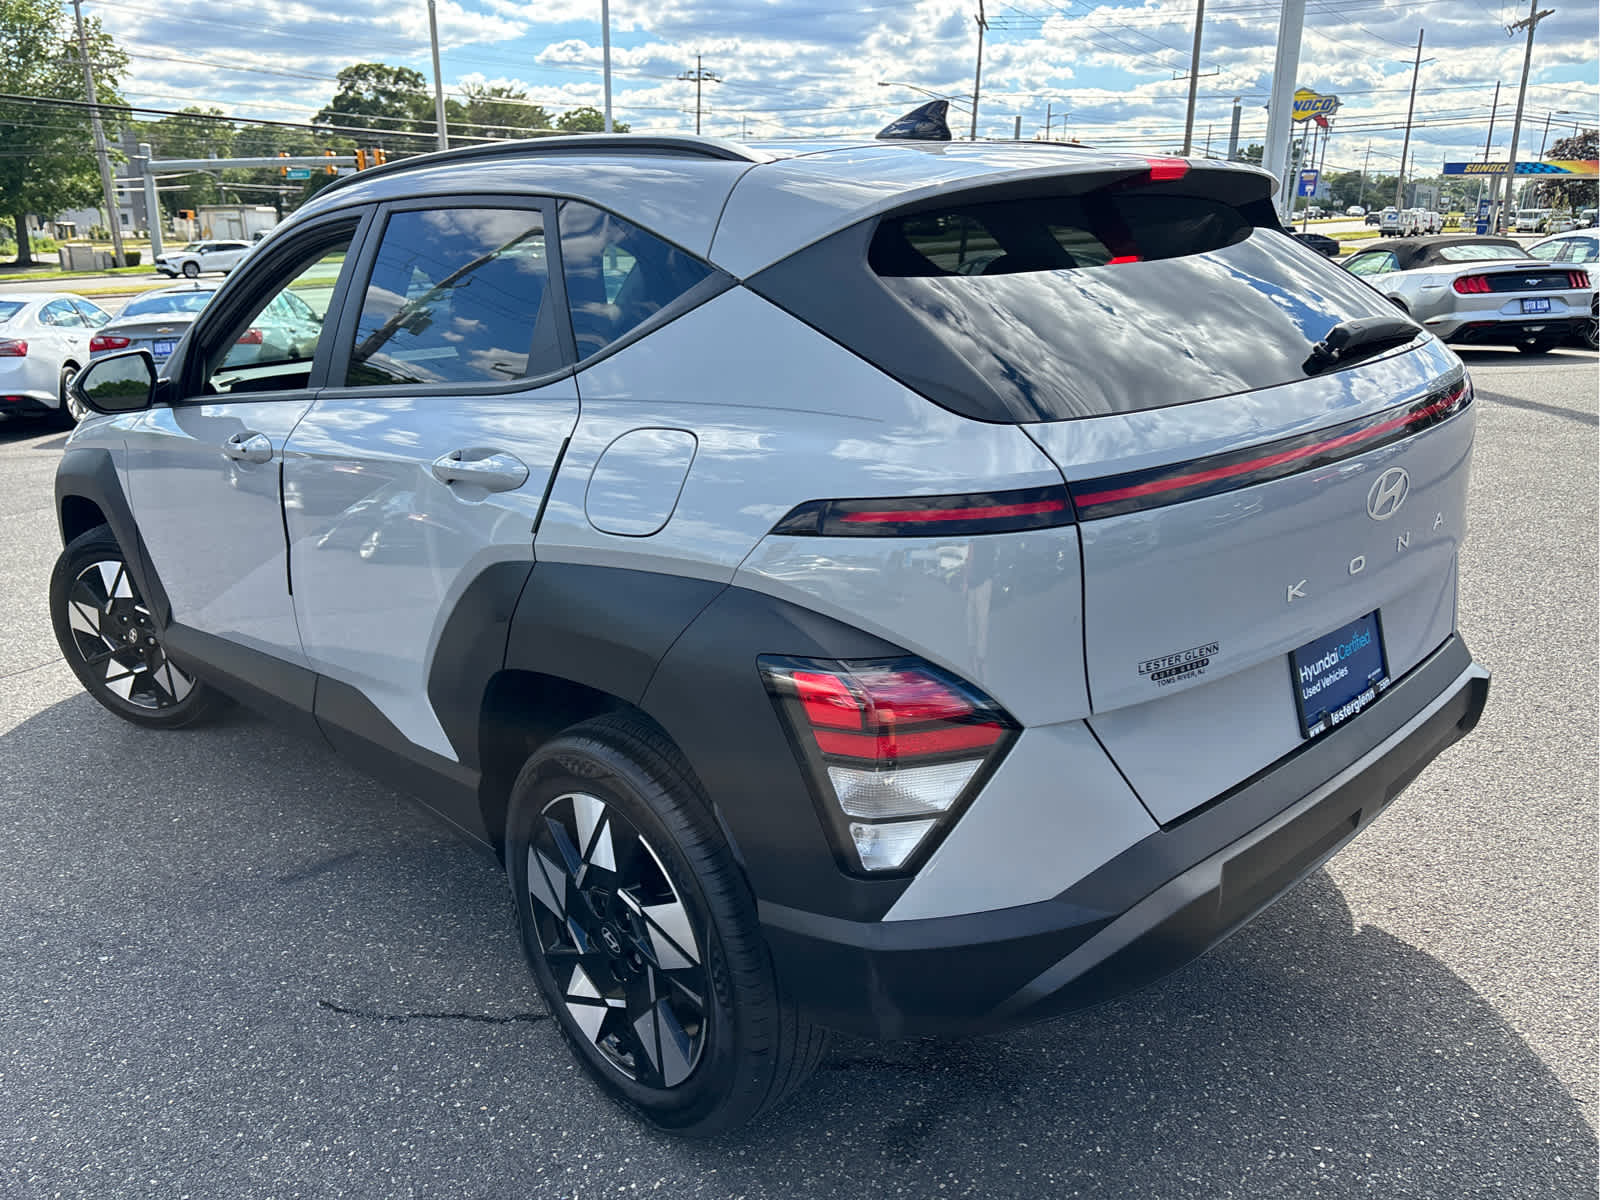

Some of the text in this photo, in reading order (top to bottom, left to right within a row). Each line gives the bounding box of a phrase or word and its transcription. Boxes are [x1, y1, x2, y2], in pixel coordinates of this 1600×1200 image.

[1293, 98, 1333, 111] NOCO
[1138, 645, 1219, 673] LESTER GLENN
[1299, 627, 1371, 683] Hyundai Certified
[1157, 677, 1176, 687] TOMS
[1303, 680, 1321, 700] Used
[1321, 666, 1349, 688] Vehicles
